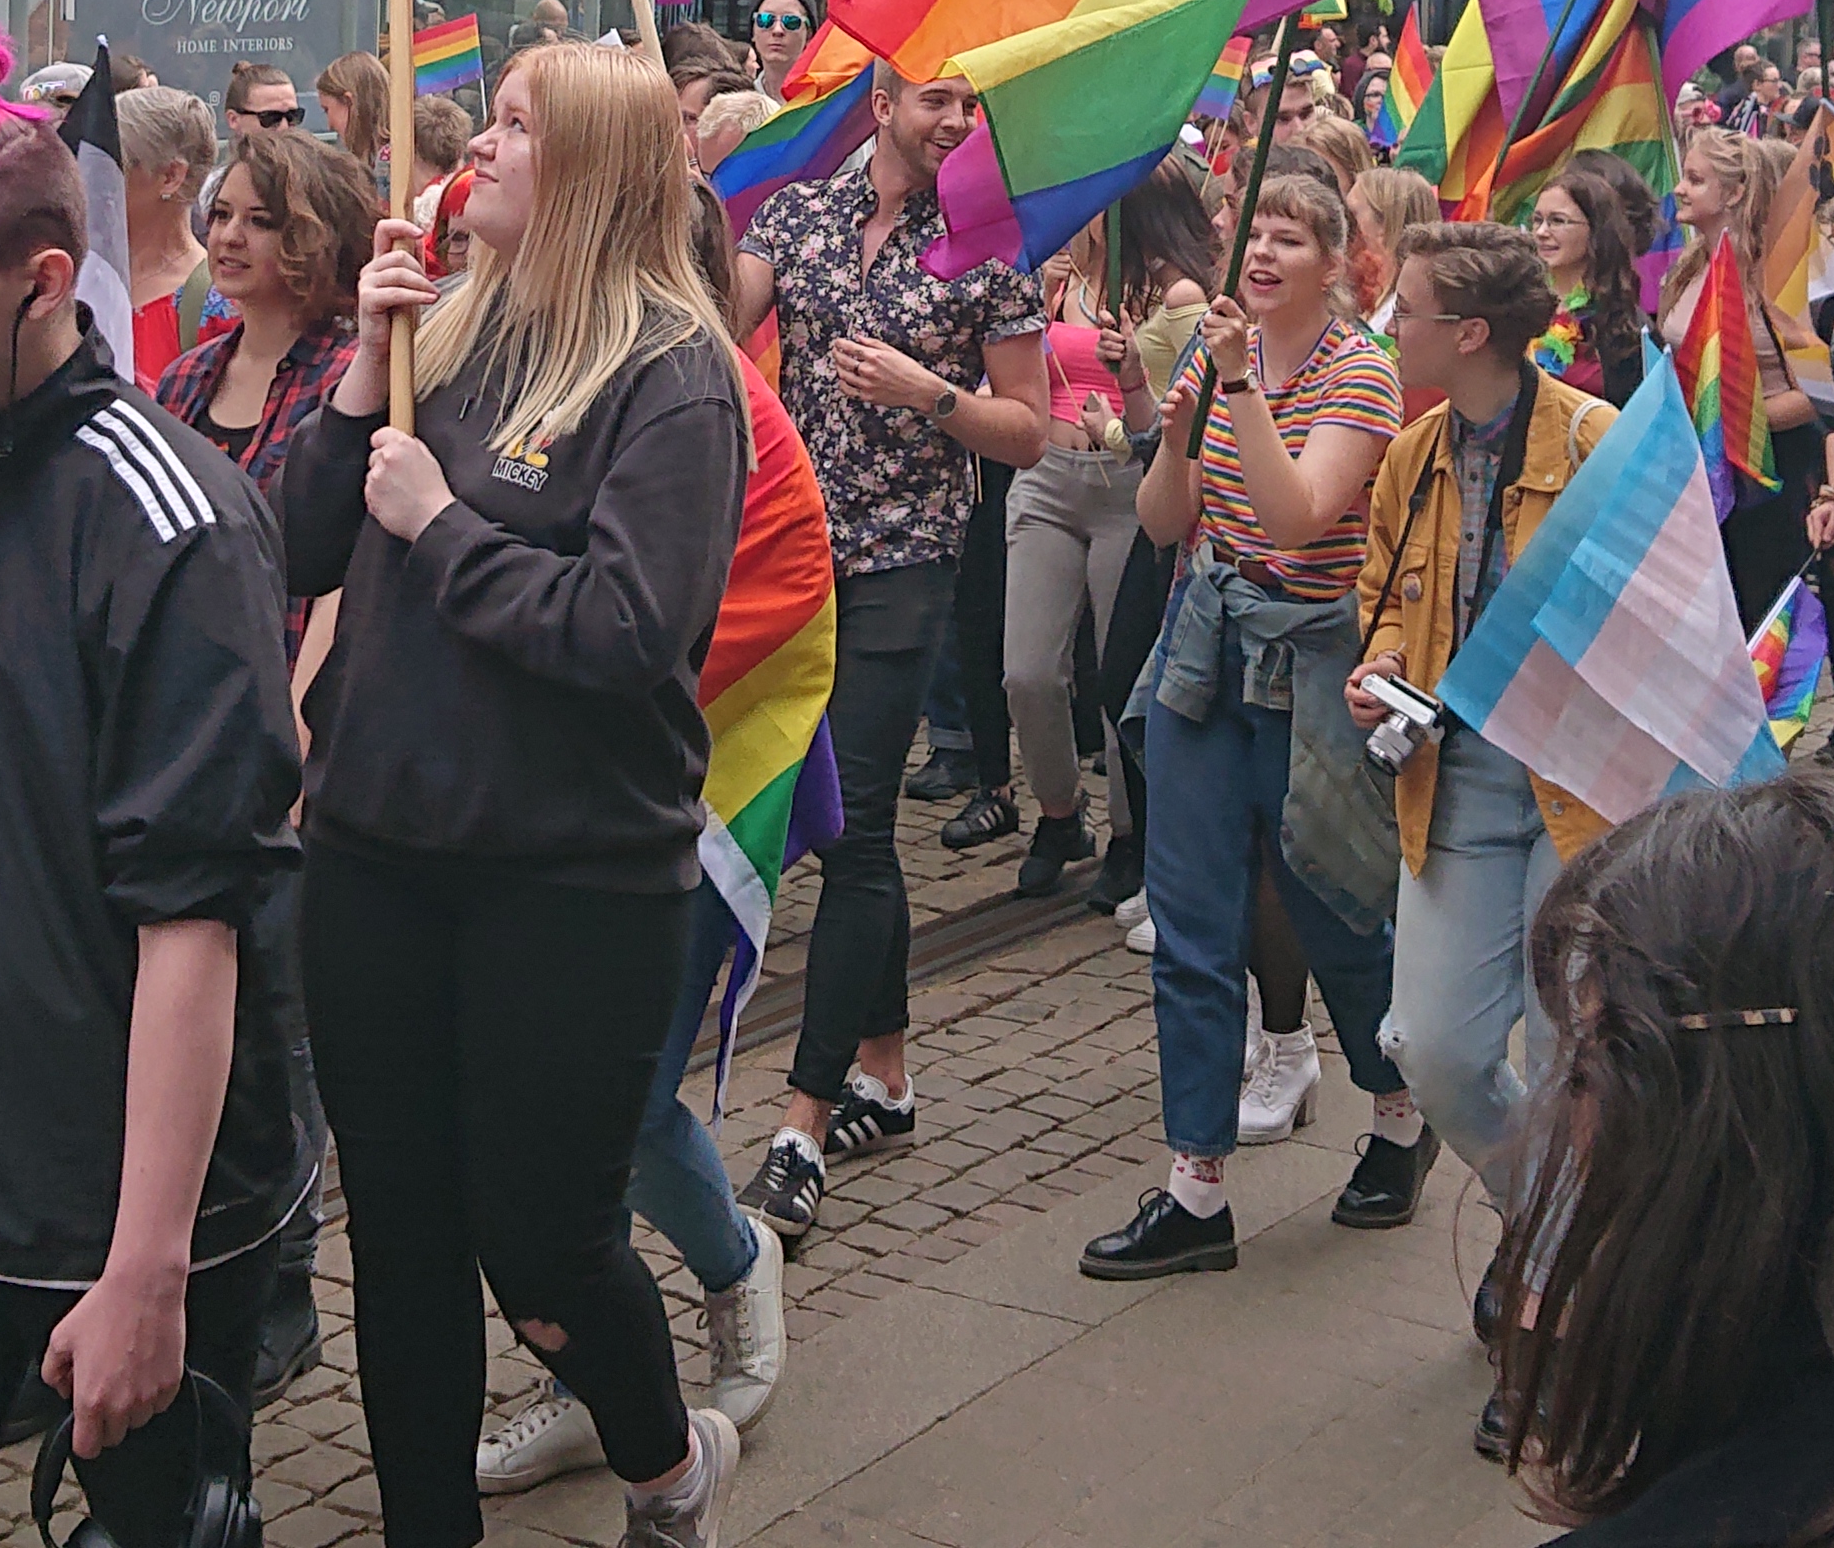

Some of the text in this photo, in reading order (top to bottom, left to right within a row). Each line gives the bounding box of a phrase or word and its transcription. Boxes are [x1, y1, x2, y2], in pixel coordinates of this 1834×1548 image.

[176, 37, 294, 54] HOME INTERIORS
[492, 457, 549, 492] MICKEY
